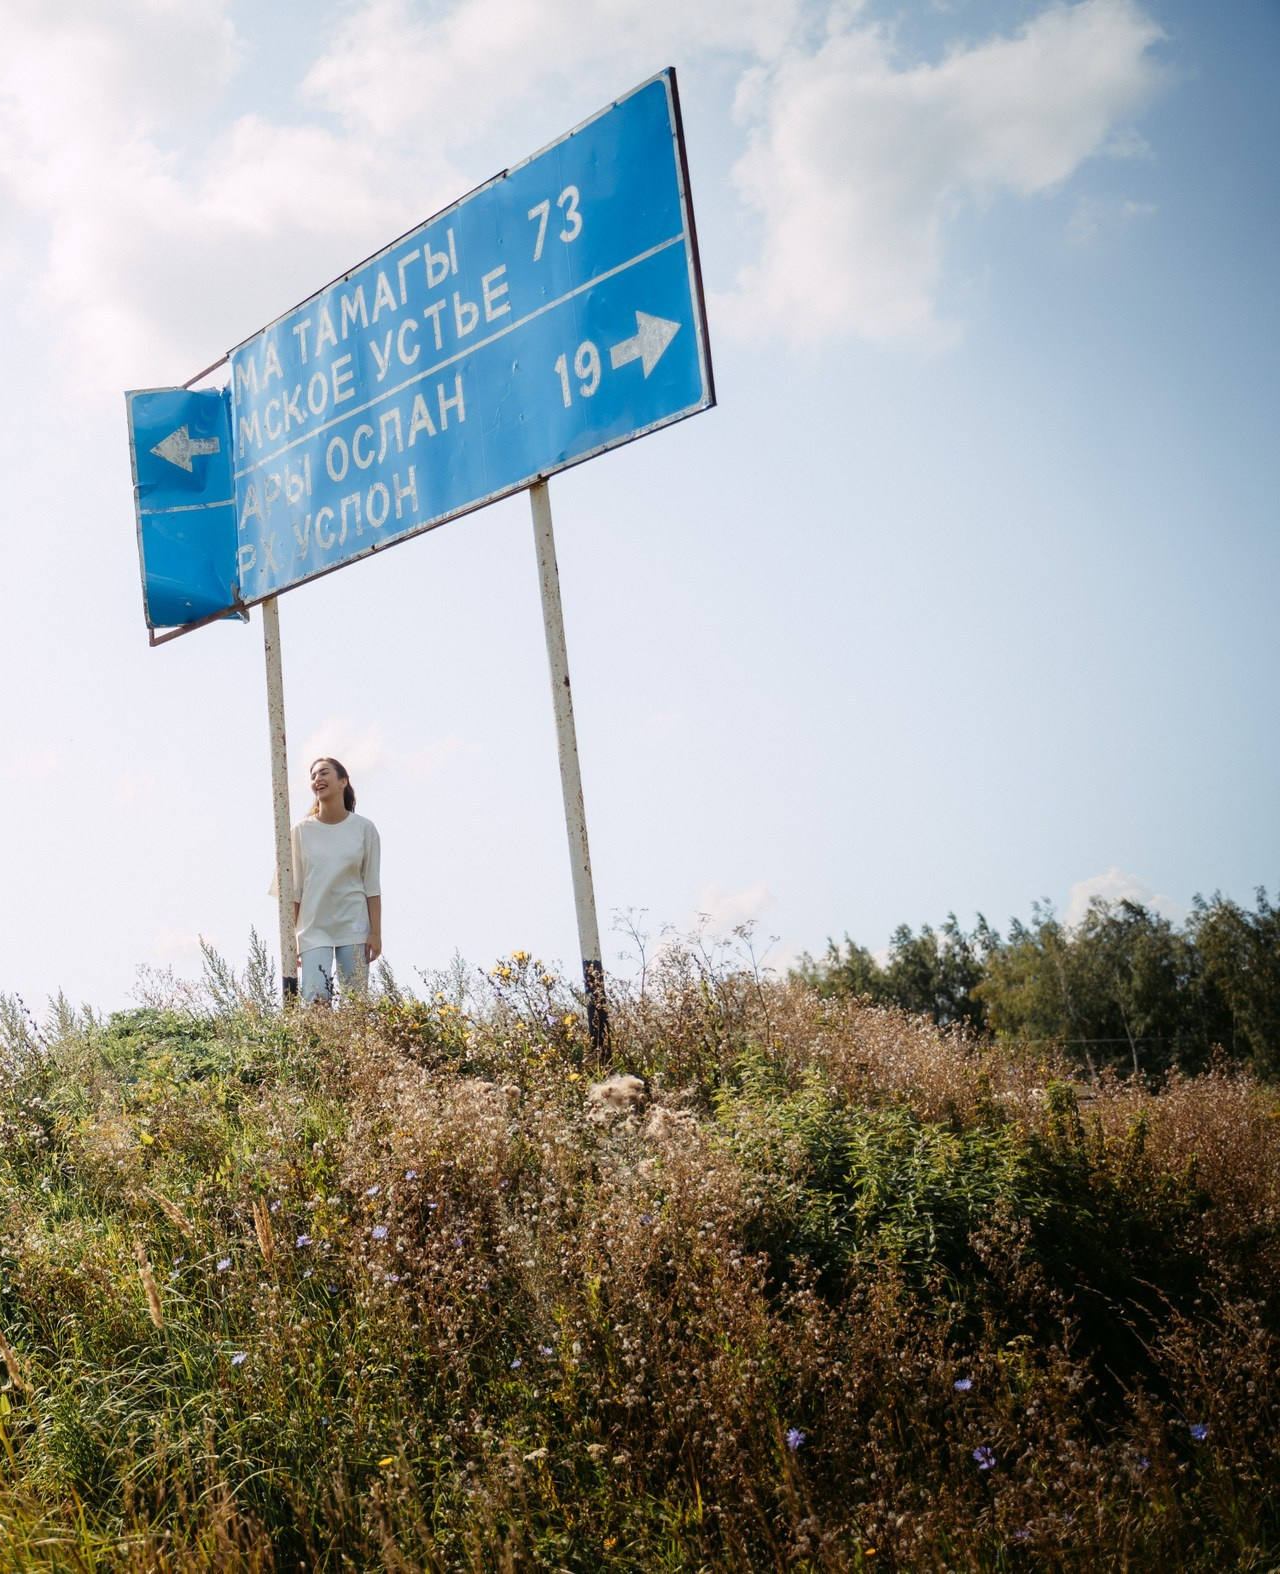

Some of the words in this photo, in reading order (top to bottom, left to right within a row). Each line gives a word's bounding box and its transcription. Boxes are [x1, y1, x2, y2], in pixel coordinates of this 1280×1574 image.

[239, 353, 355, 459] МСКОЕ
[369, 264, 511, 383] УСТЬЕ
[293, 228, 459, 364] ТАМАГЫ
[528, 185, 583, 262] 73
[239, 453, 312, 530] АРЫ
[326, 375, 466, 482] ОСЛАН
[554, 341, 602, 408] 19
[292, 464, 419, 560] УСЛОН
